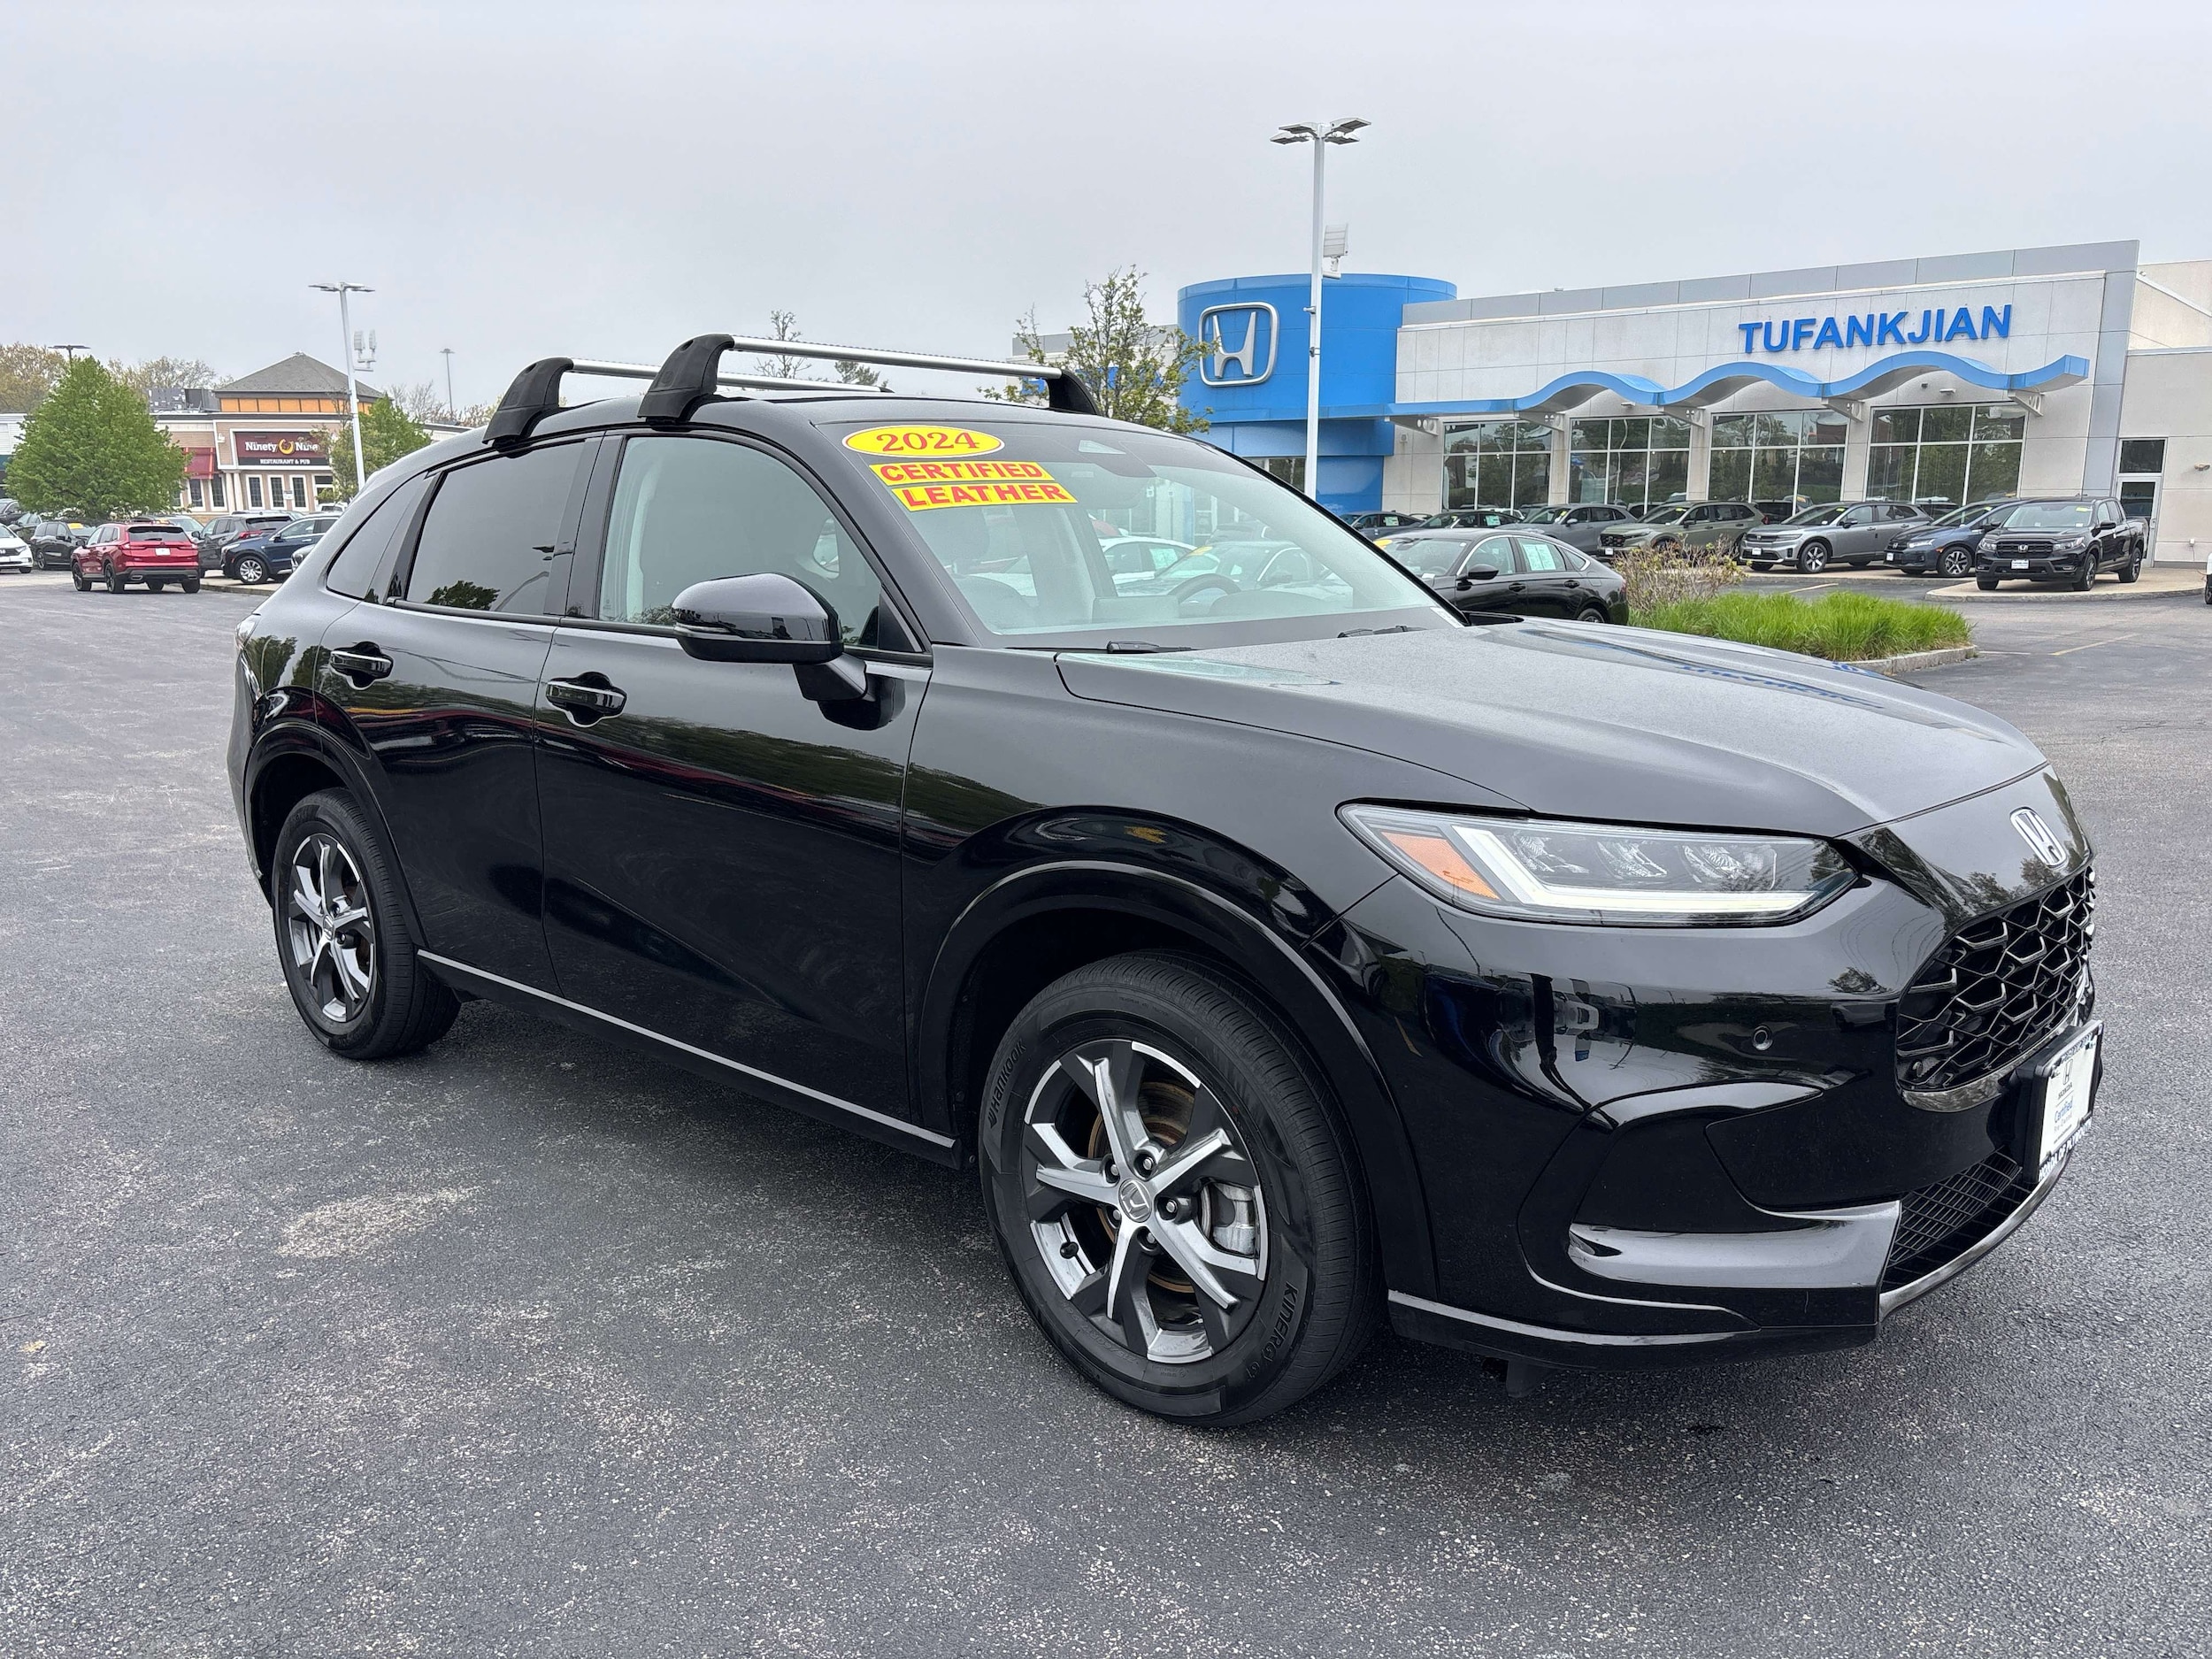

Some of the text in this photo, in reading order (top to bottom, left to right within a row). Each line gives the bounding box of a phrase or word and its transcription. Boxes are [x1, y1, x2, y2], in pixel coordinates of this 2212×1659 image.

[1738, 303, 2012, 354] TUFANKJIAN
[245, 442, 319, 452] Ninety Nine
[876, 432, 980, 452] 2024
[880, 462, 1043, 481] CERTIFIED
[902, 484, 1069, 507] LEATHER
[2055, 1095, 2074, 1123] Certified
